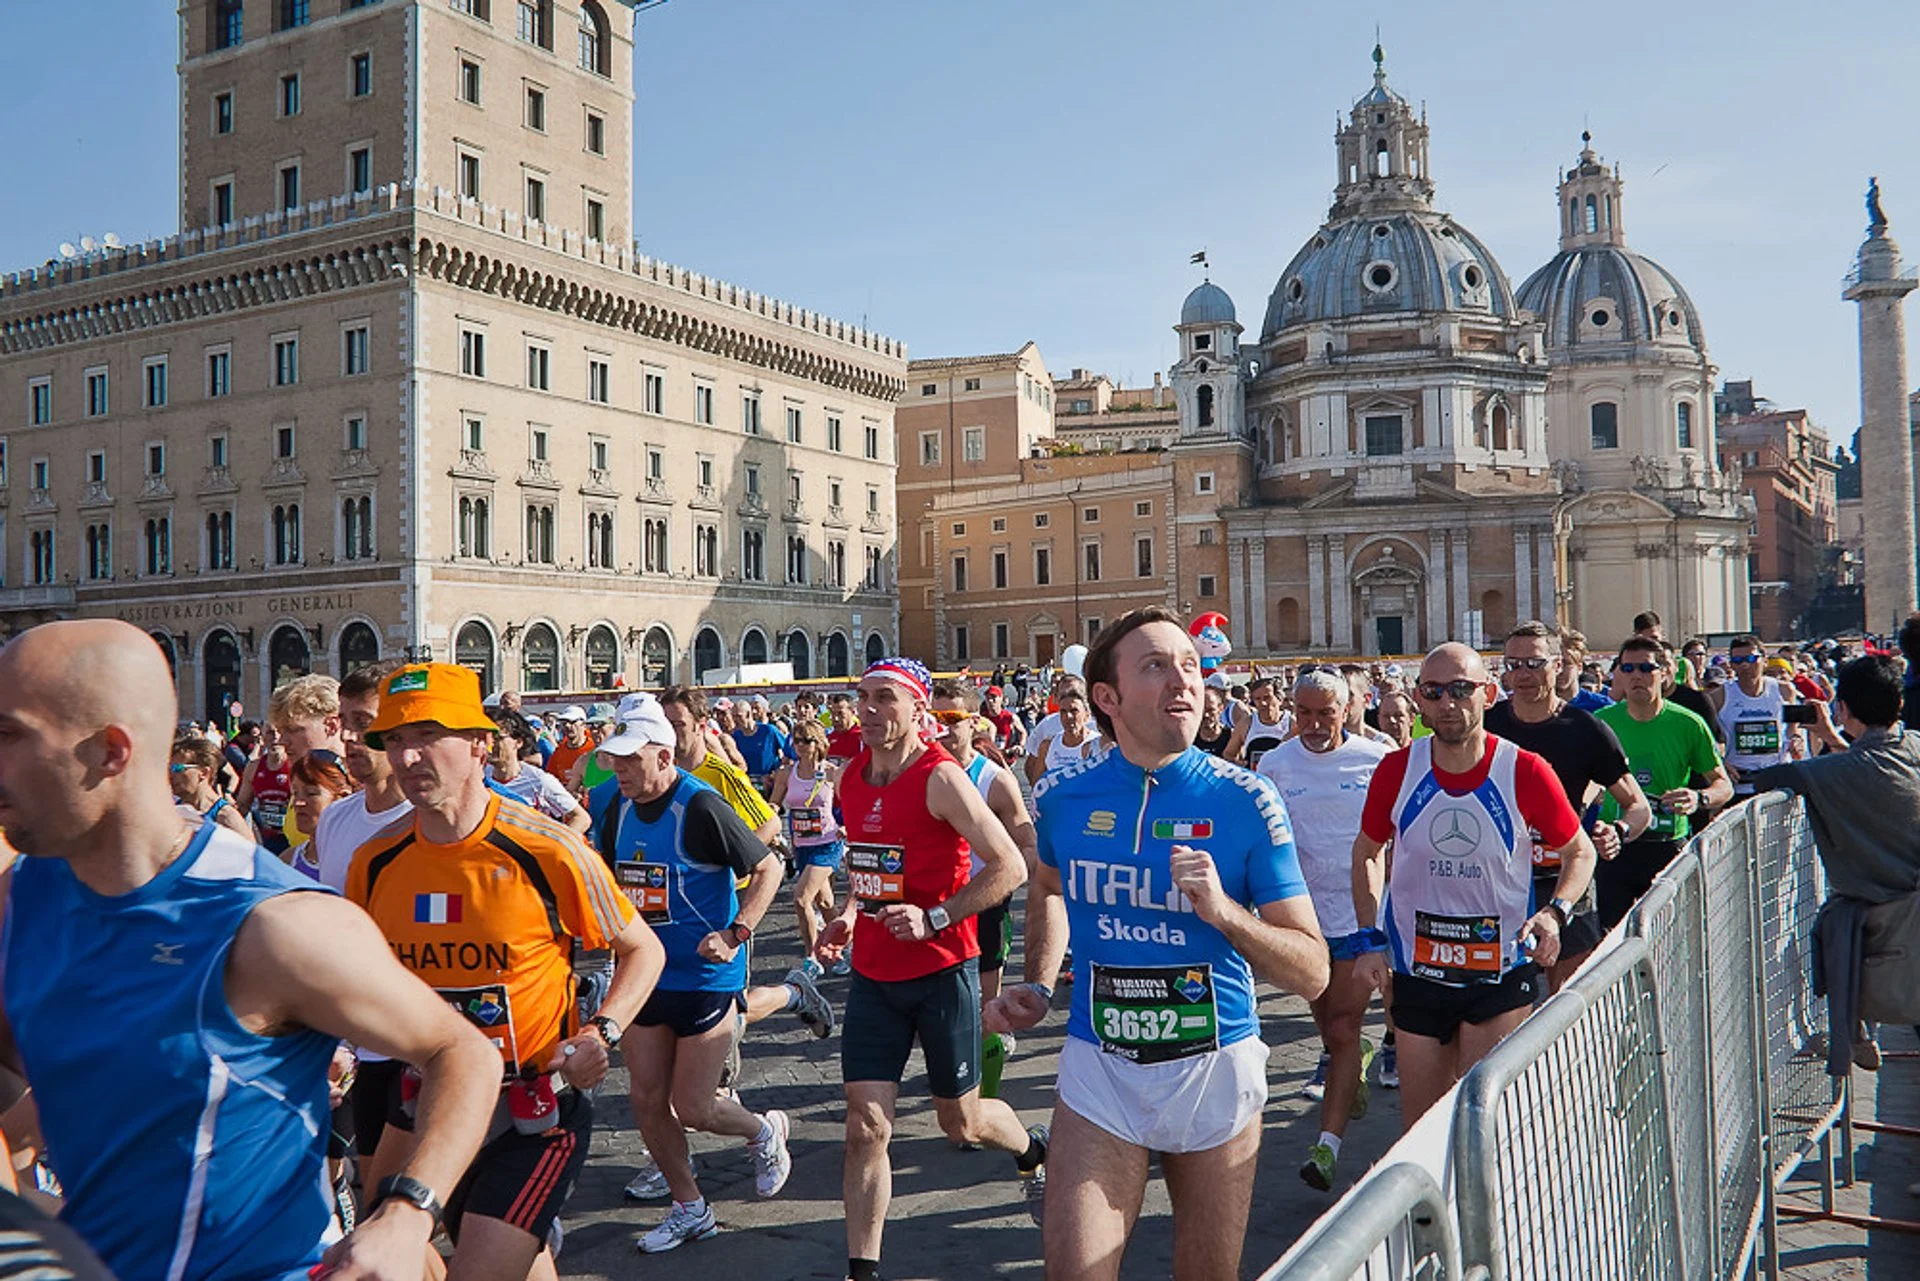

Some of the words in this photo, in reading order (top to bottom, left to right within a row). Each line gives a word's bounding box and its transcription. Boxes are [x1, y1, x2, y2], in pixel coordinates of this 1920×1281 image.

[267, 595, 354, 613] GENERALI
[1457, 861, 1482, 879] Auto
[1097, 914, 1186, 946] Škoda
[1428, 941, 1467, 966] 703
[1103, 1007, 1179, 1040] 3632
